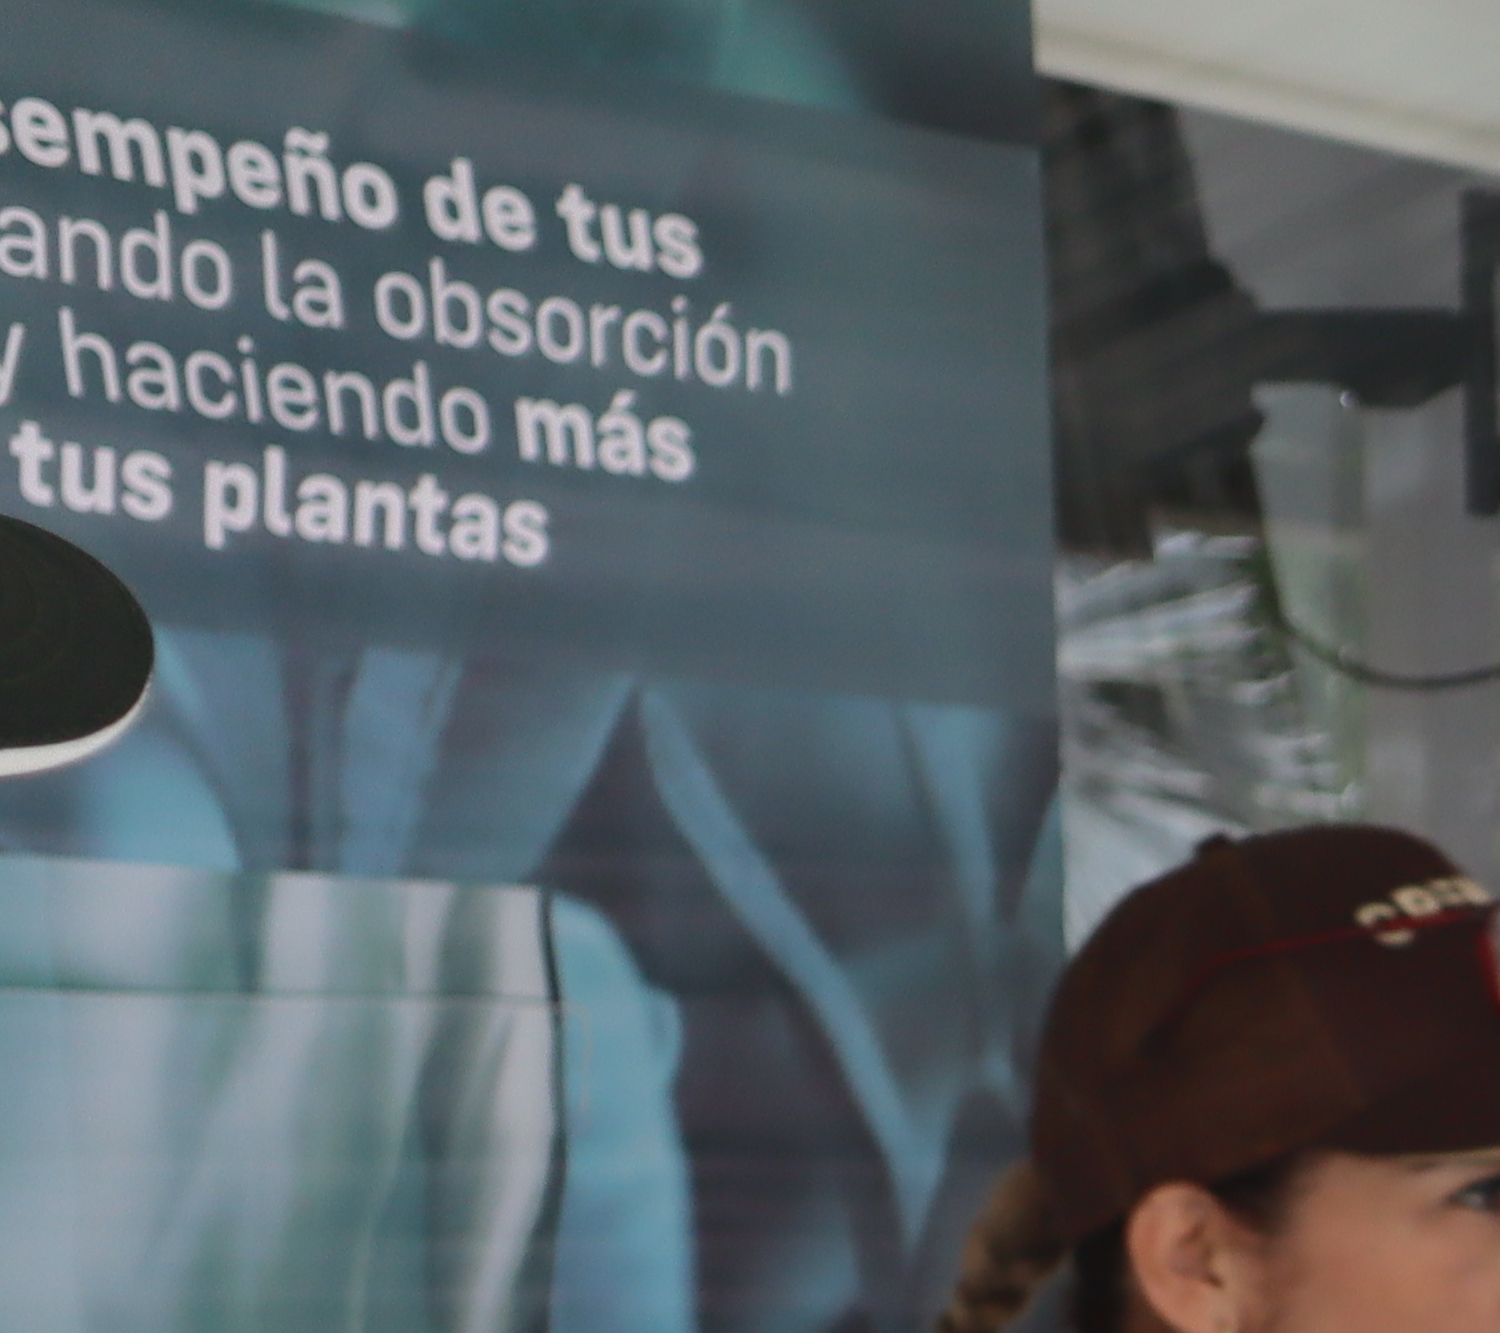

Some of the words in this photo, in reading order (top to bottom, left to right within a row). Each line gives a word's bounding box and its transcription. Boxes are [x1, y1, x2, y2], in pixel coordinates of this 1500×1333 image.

[421, 157, 537, 251] de
[556, 183, 704, 279] tus
[0, 207, 233, 310] ando
[260, 229, 345, 328] la
[375, 256, 796, 397] obsorción
[58, 307, 492, 456] haciendo
[514, 390, 696, 483] más
[8, 419, 174, 522] tus
[203, 445, 552, 569] plantas
